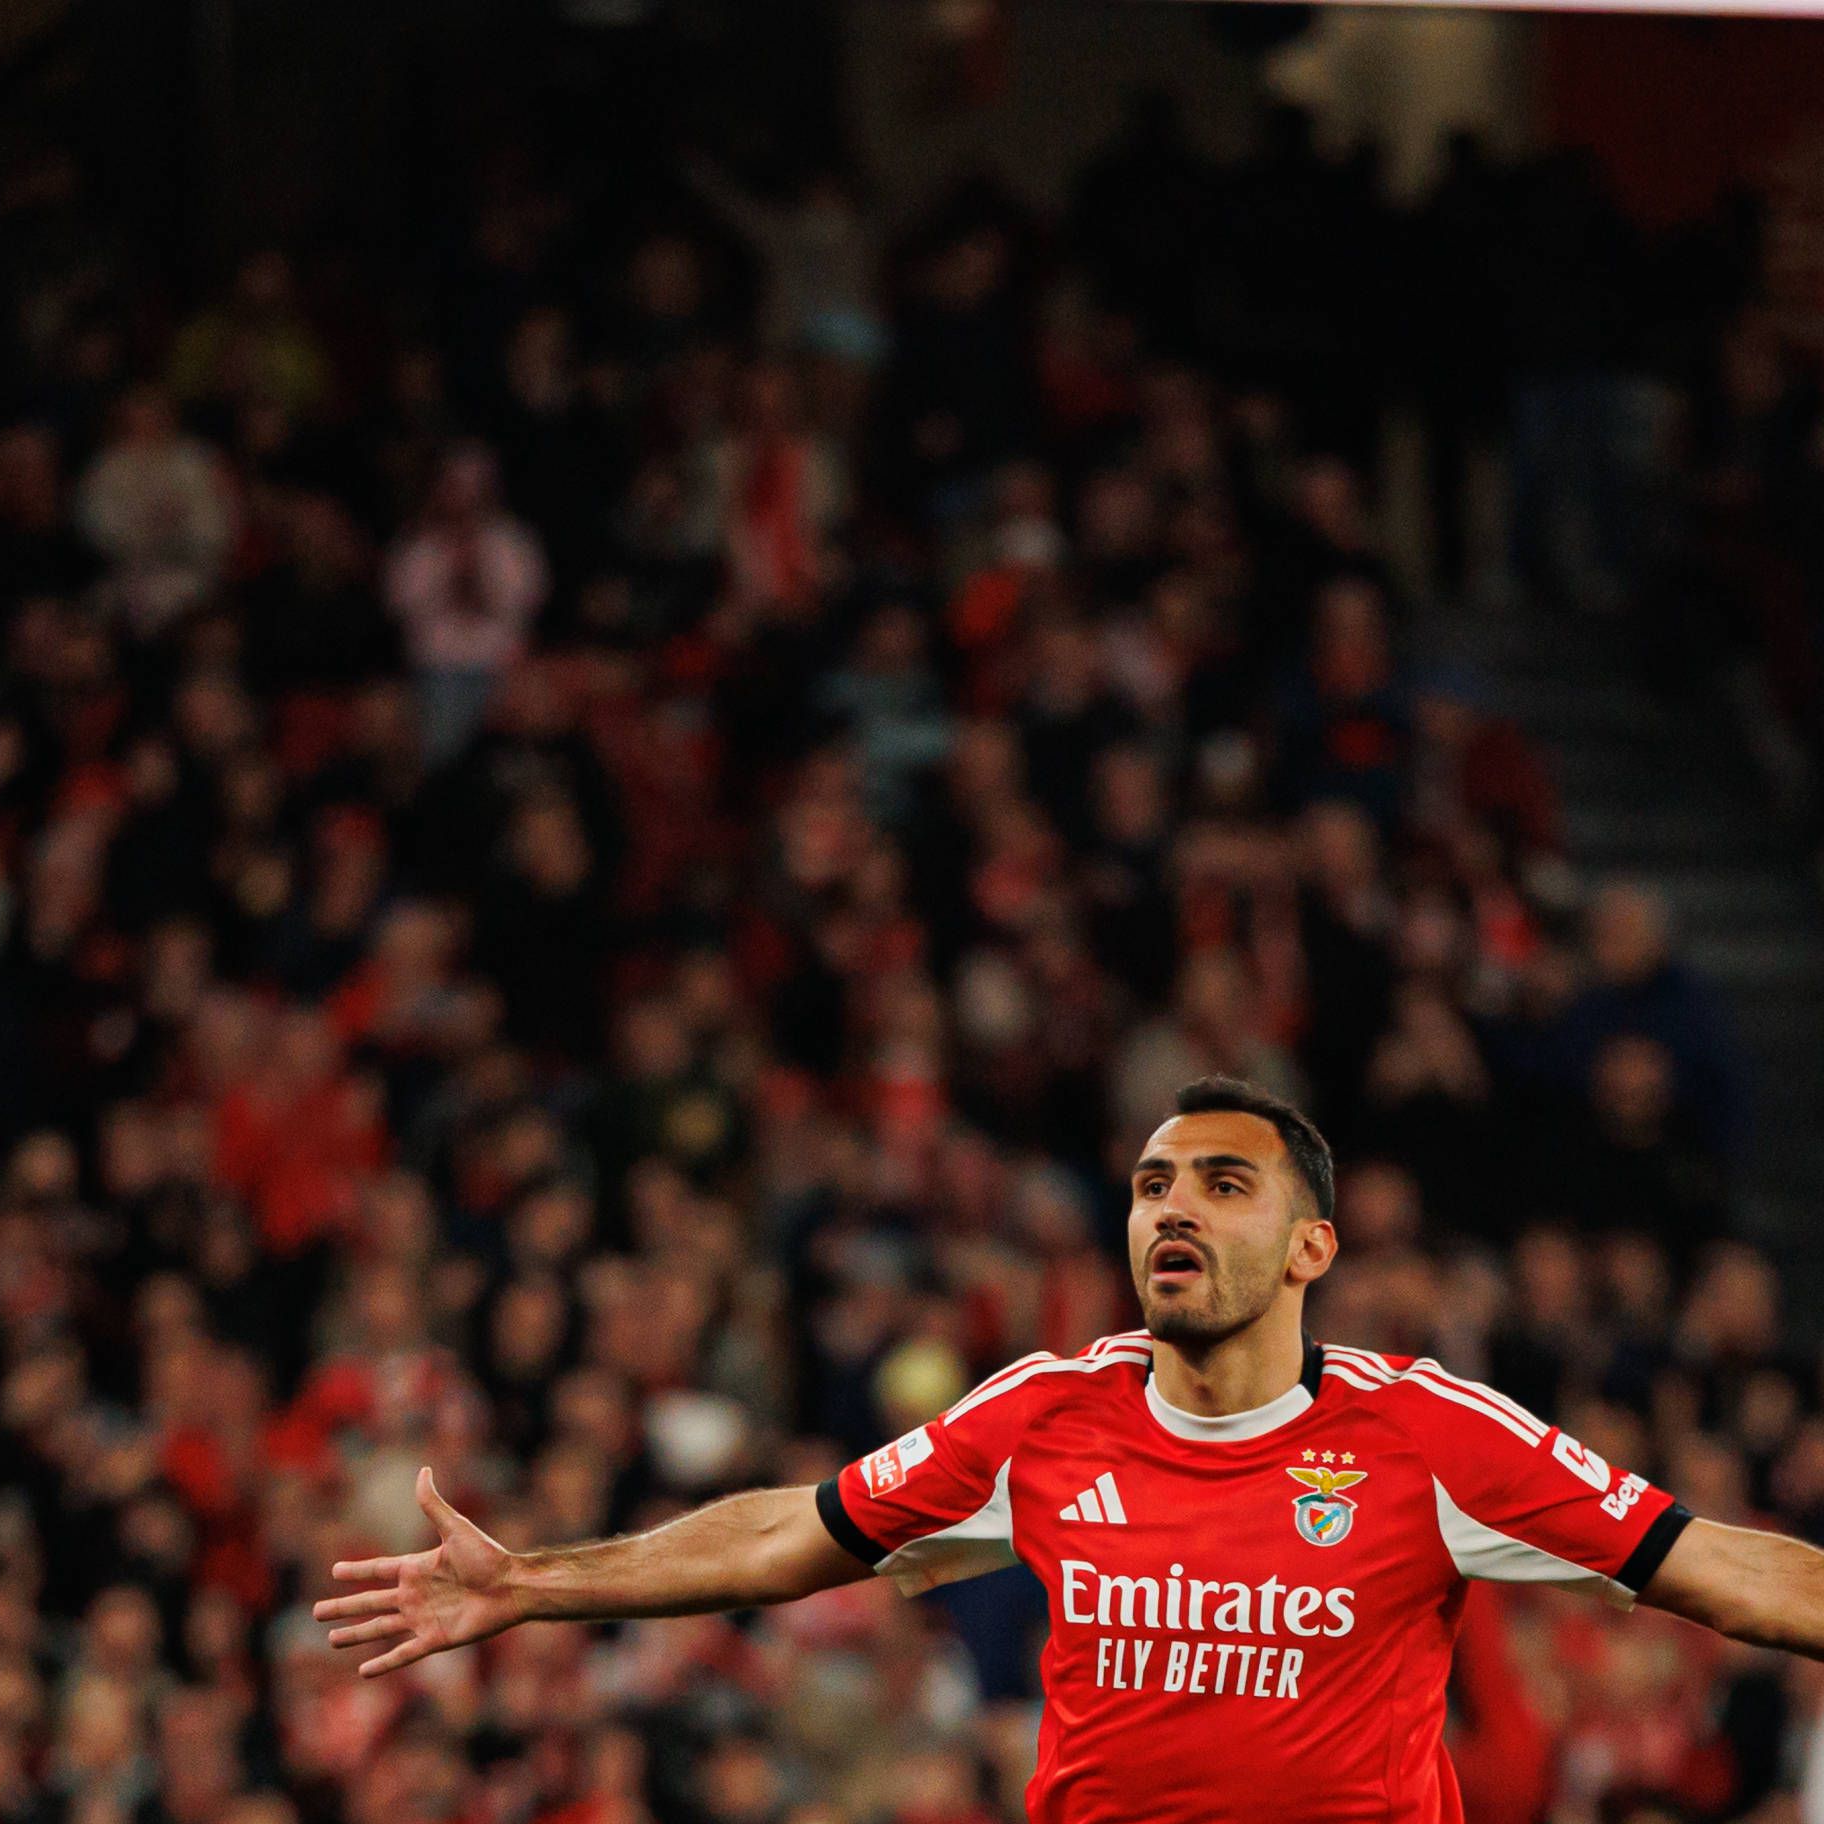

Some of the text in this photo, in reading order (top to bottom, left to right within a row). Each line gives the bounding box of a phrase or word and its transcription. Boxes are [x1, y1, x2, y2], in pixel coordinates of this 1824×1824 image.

[1060, 1559, 1356, 1638] Emirates
[1096, 1638, 1305, 1700] FLY BETTER
